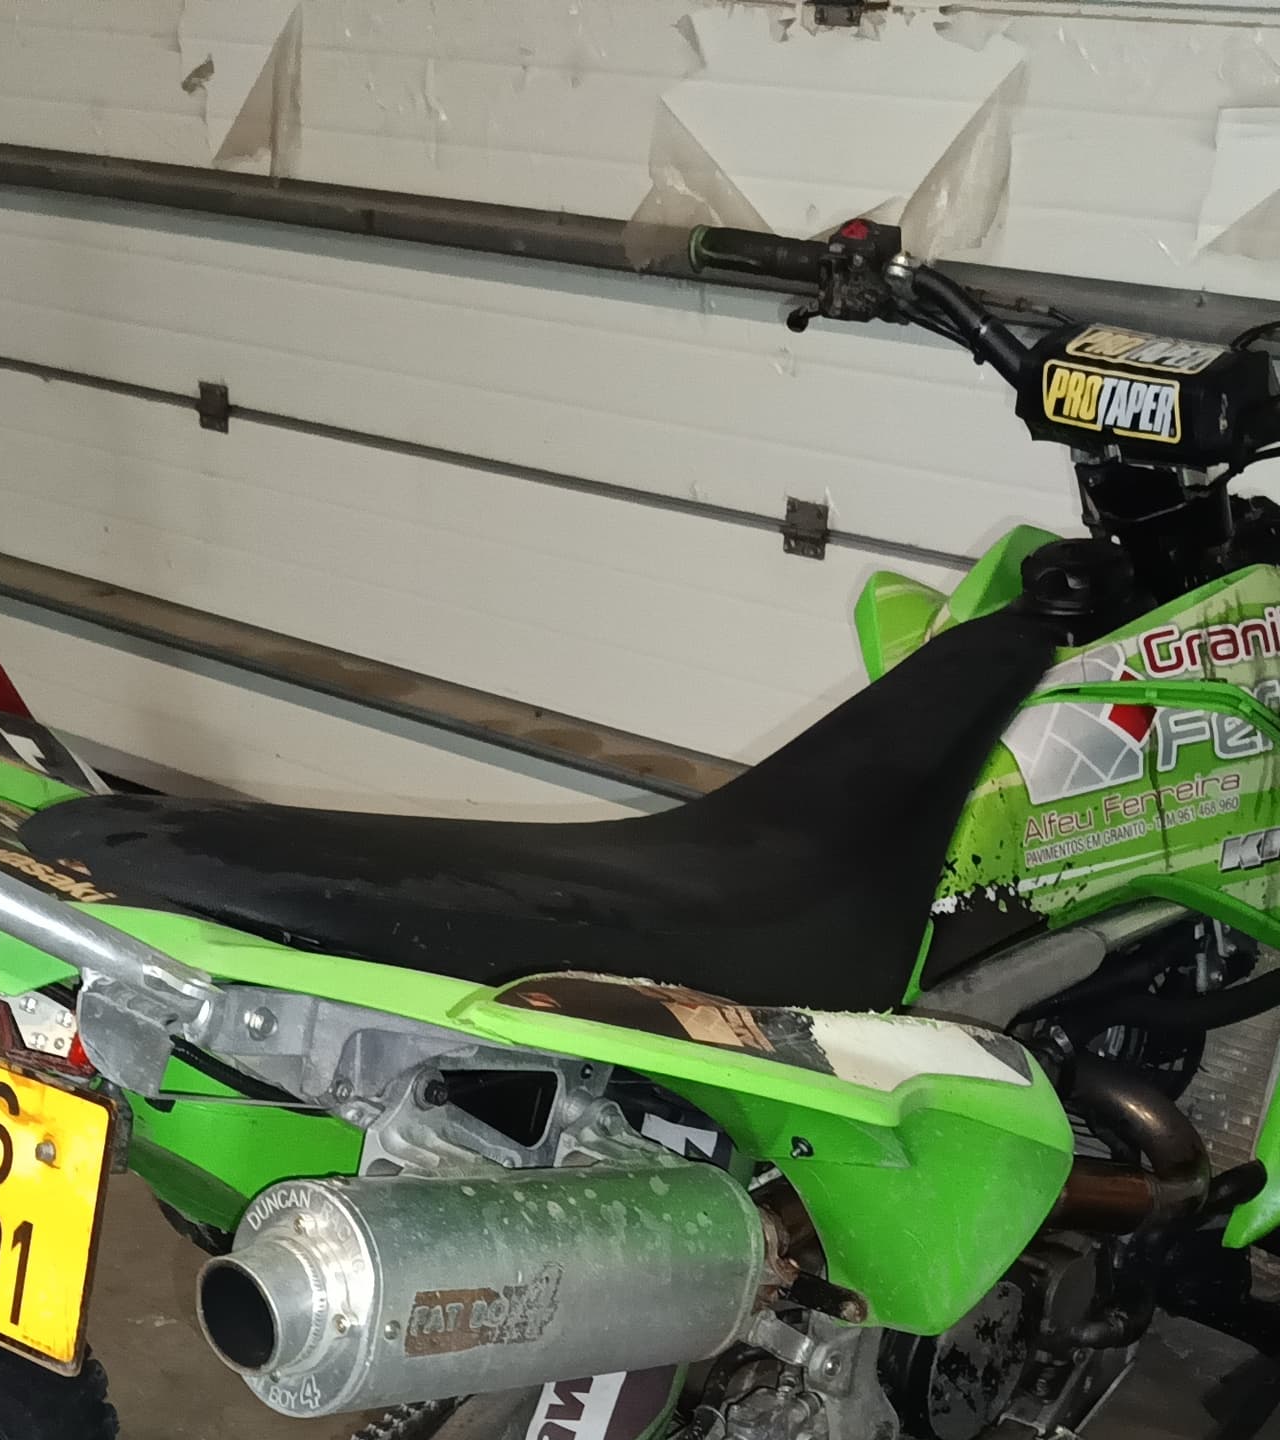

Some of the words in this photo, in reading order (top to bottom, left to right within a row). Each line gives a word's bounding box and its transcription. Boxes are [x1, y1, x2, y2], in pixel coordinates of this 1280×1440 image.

[1047, 367, 1176, 438] PROTAPER
[1025, 809, 1093, 844] Alfeu
[1103, 773, 1241, 823] Ferreira
[1025, 838, 1085, 866] PAVIMENTOS
[1085, 834, 1102, 850] EM
[1103, 821, 1146, 844] GRANITO
[1177, 806, 1195, 823] 961
[1199, 801, 1217, 817] 468
[1219, 796, 1239, 812] 960
[246, 1189, 311, 1232] DUNCAN
[269, 1385, 298, 1409] BOY
